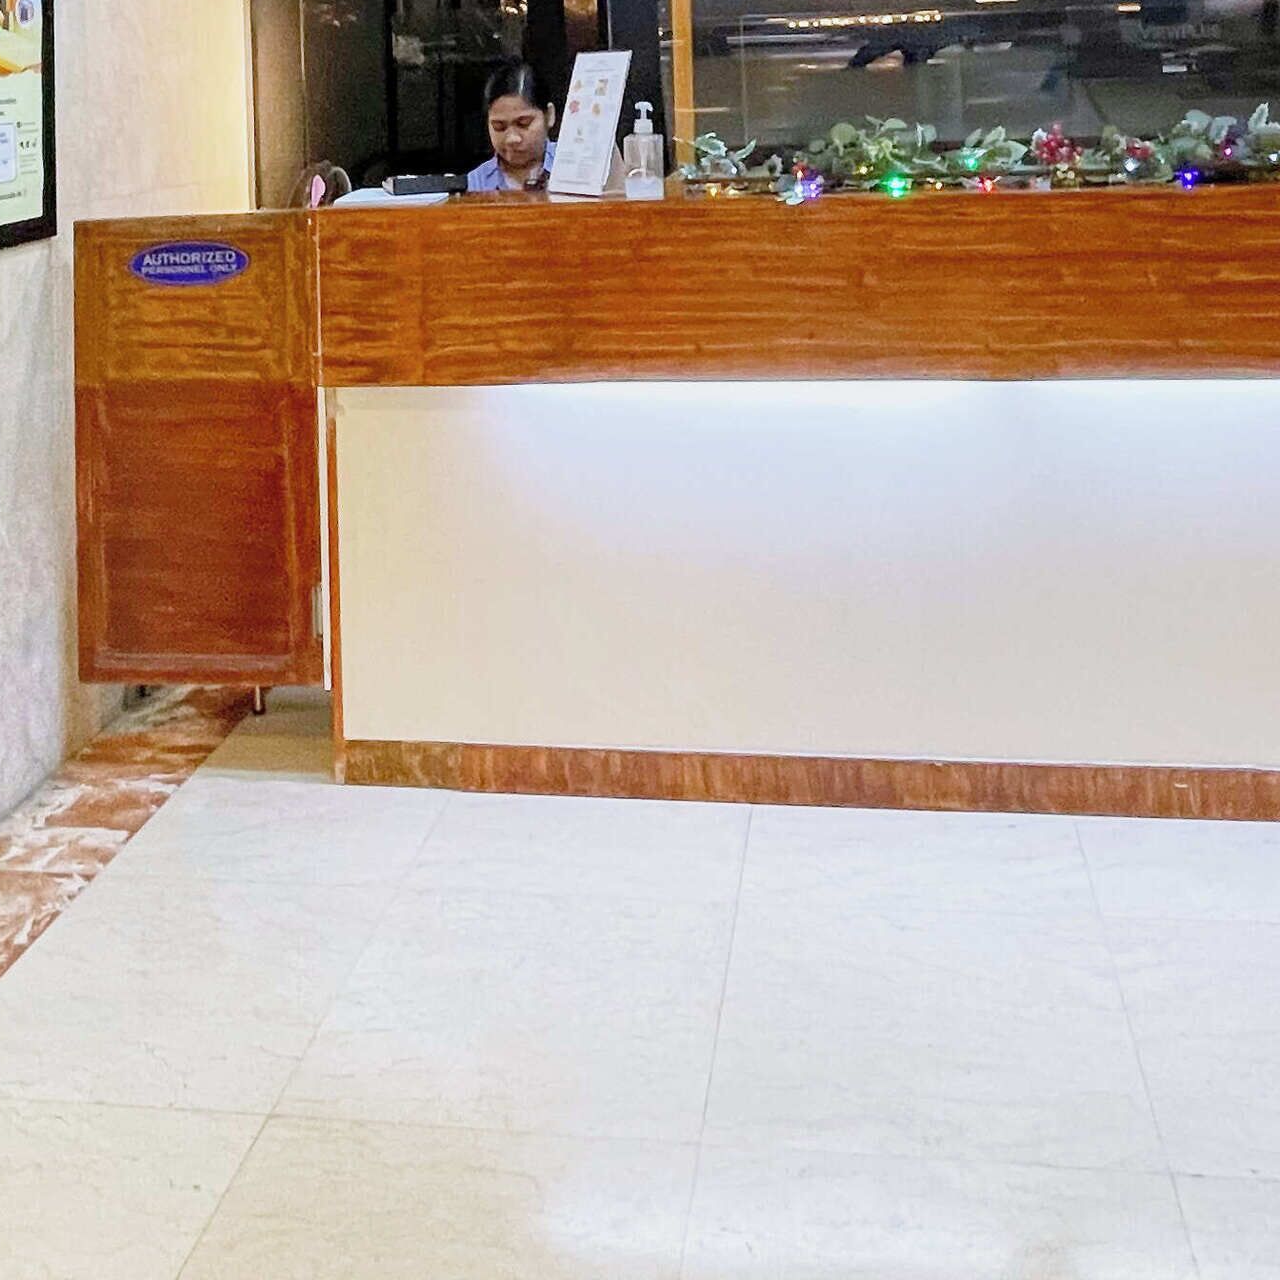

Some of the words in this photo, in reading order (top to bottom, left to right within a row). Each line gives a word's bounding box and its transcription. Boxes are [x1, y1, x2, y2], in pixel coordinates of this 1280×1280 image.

[143, 250, 236, 266] AUTHORIZED
[141, 265, 206, 275] PERSONNEL
[209, 263, 237, 273] ONLY
